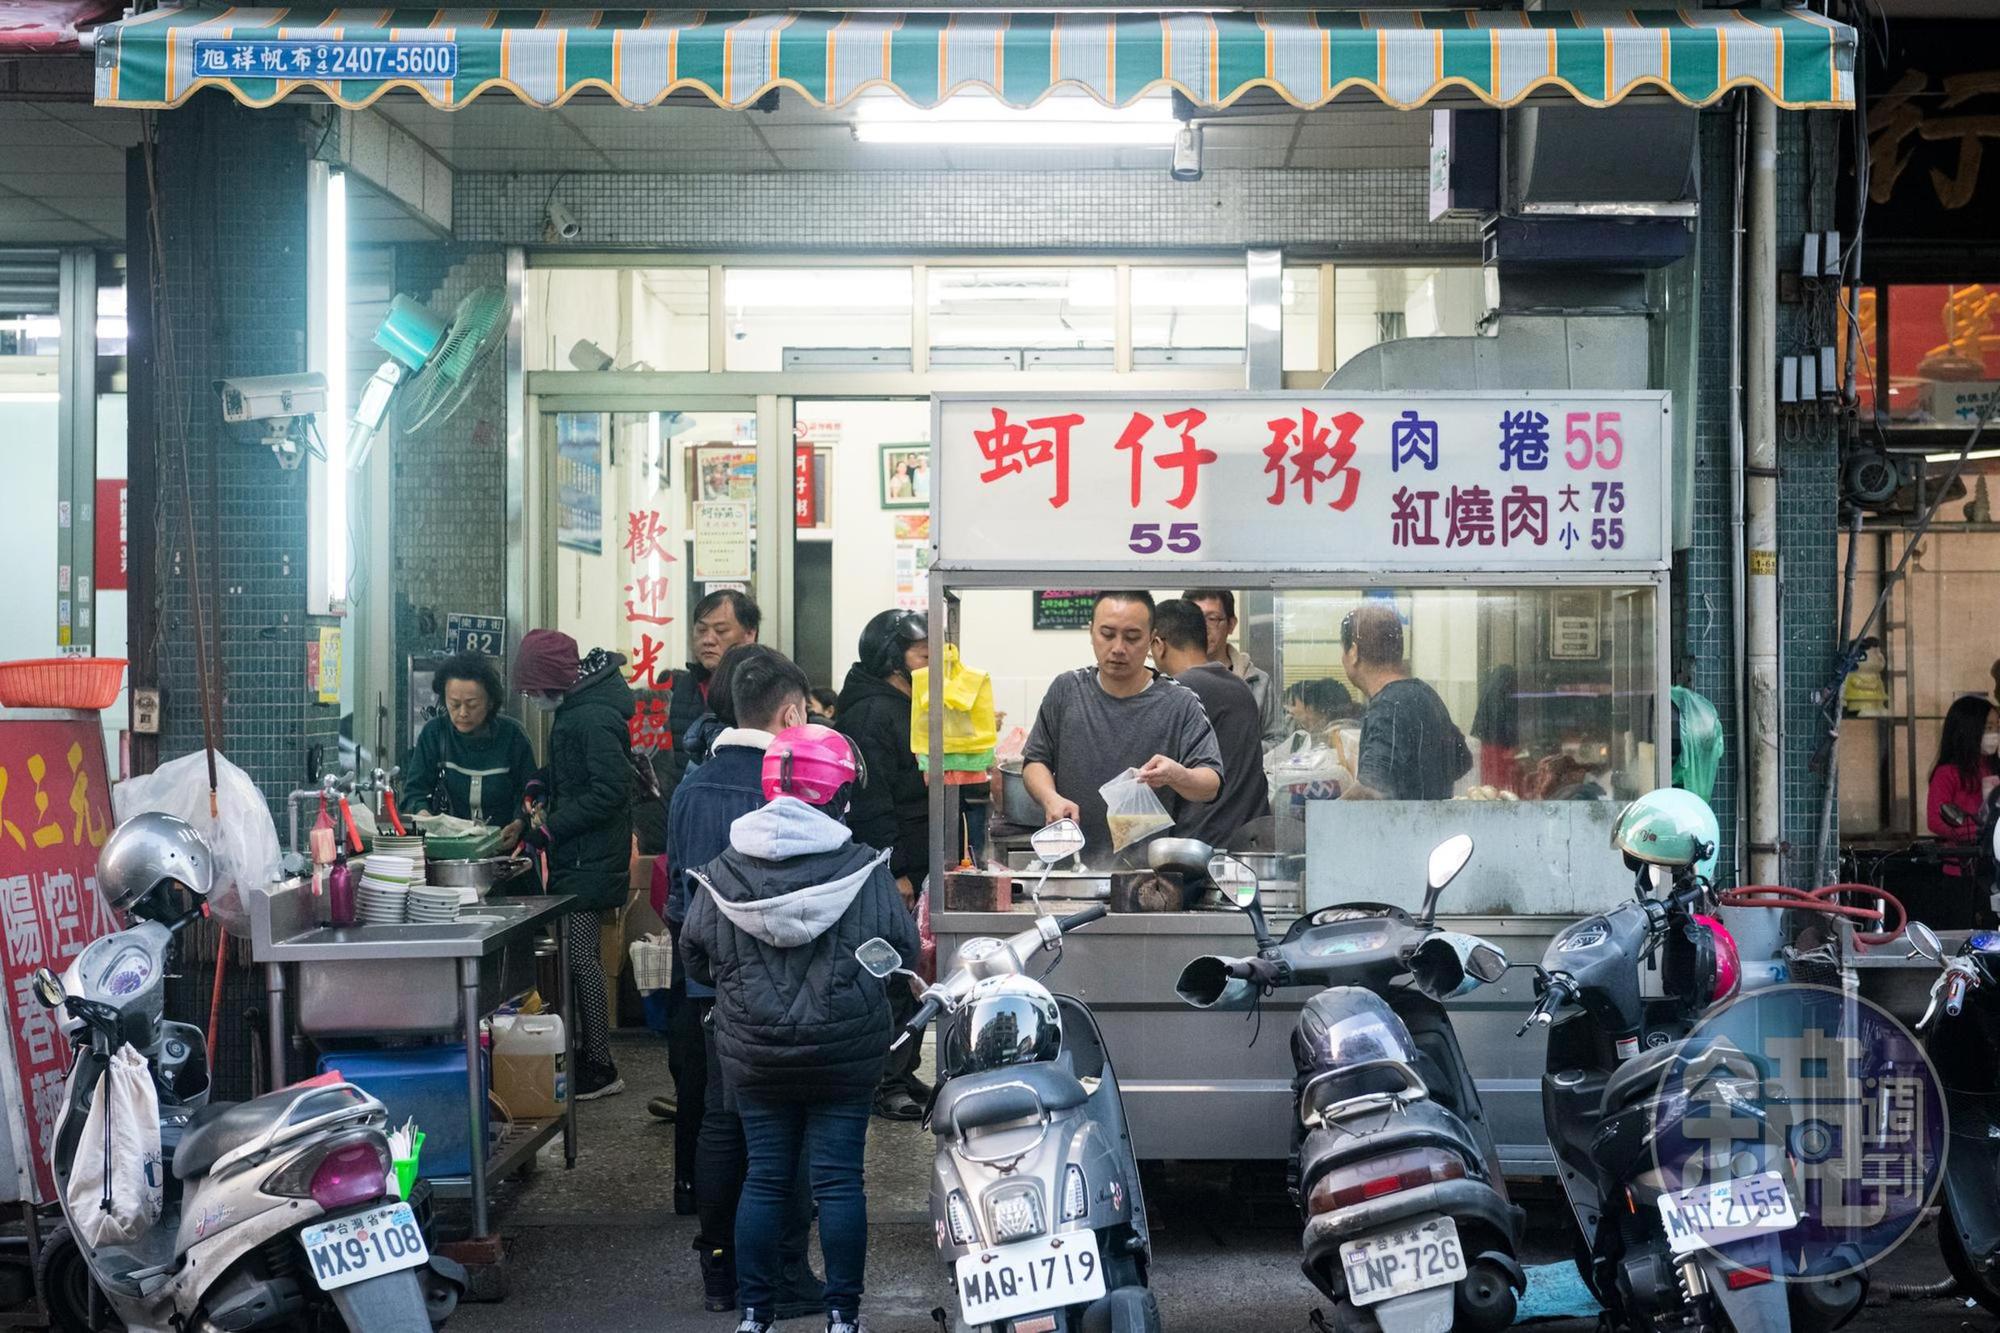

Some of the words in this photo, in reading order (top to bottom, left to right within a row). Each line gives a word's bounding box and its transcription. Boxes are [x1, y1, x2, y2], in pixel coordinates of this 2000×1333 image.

[202, 46, 312, 73] 旭祥帆布
[332, 46, 450, 74] 2407-5600
[1565, 411, 1624, 471] 55
[973, 407, 1364, 512] 蚵仔粥
[1391, 484, 1549, 548] 紅燒肉
[1558, 484, 1581, 512] 大
[1591, 482, 1625, 514] 75
[1128, 523, 1201, 554] 55
[1559, 521, 1580, 550] 小
[1591, 518, 1625, 550] 55
[467, 633, 493, 654] 82
[624, 510, 678, 751] 歡迎光臨
[327, 1213, 379, 1236] 台灣省
